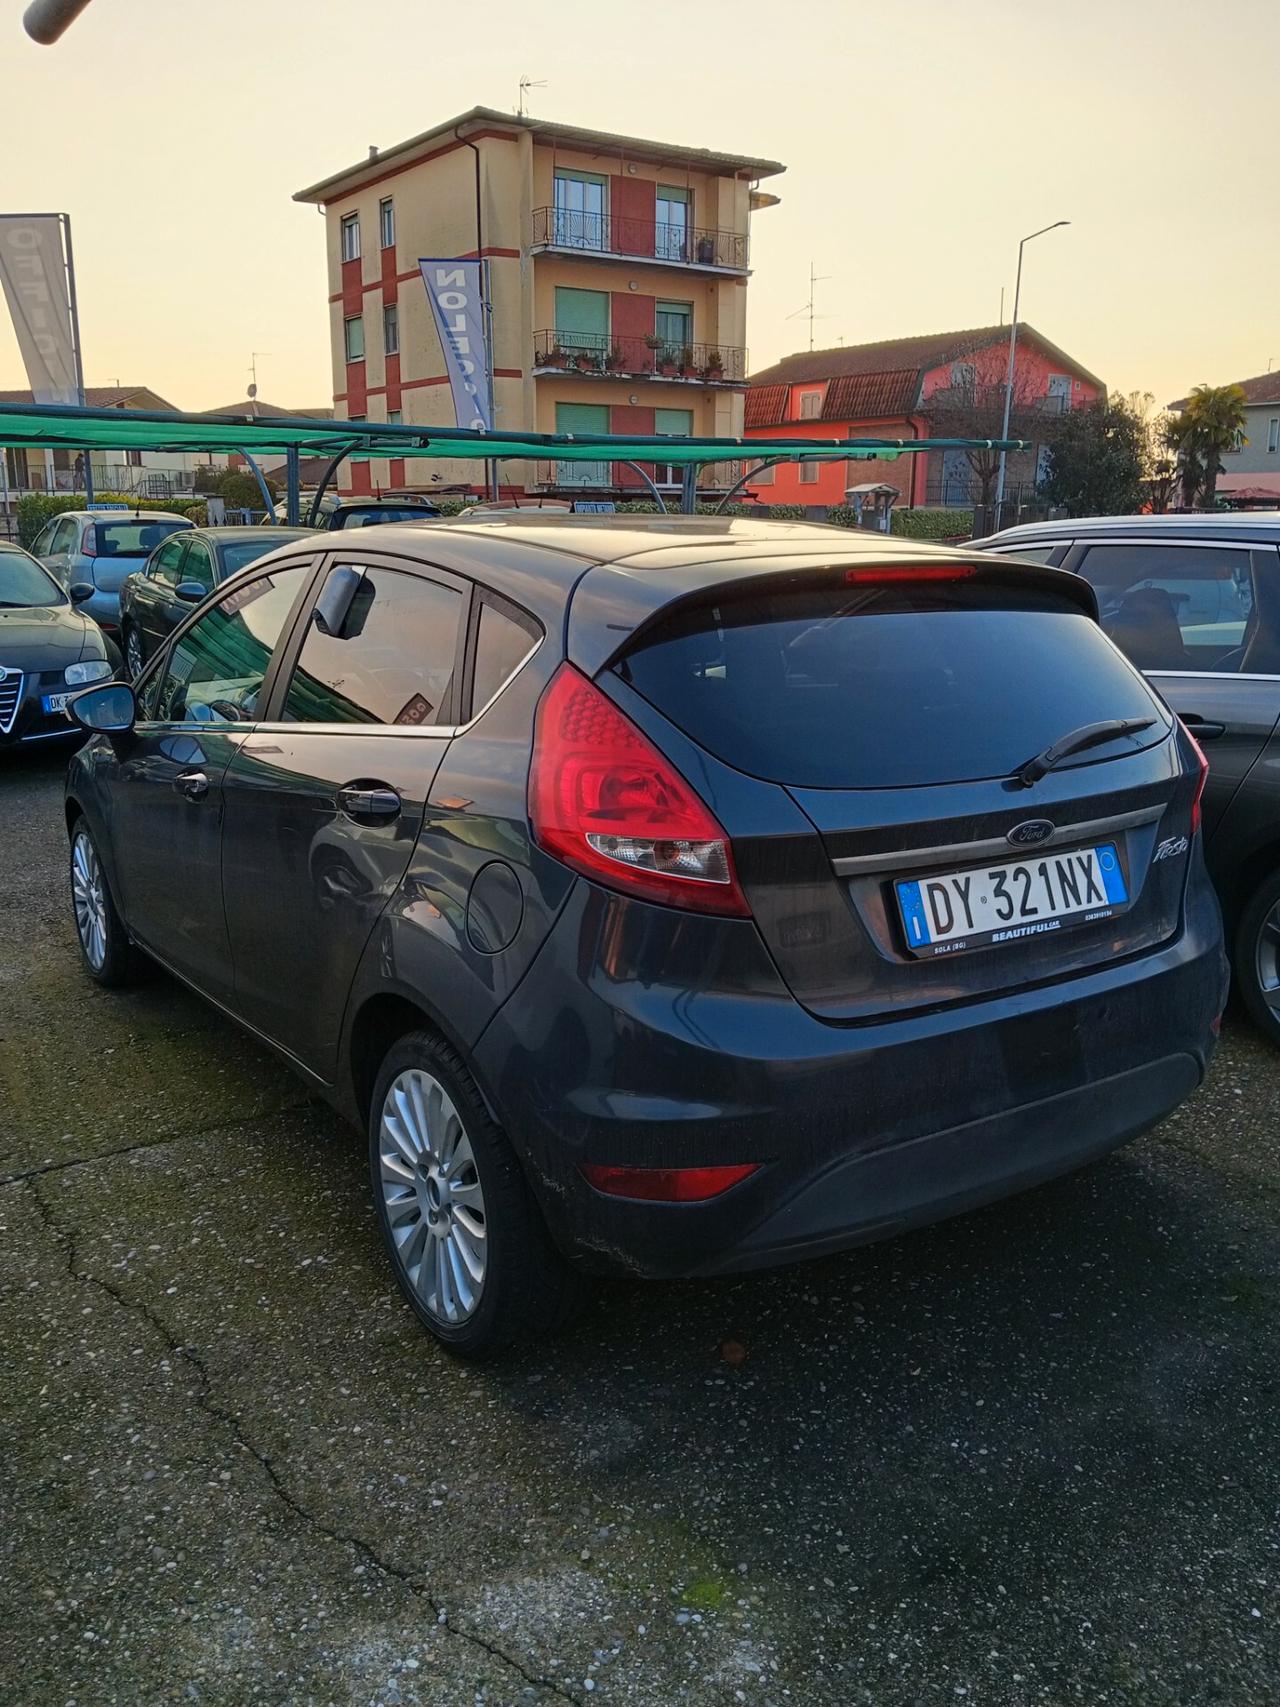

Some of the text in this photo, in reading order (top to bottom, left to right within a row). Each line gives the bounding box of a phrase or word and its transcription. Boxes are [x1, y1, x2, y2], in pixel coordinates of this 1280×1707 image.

[1019, 824, 1046, 841] Ford
[1152, 836, 1189, 863] Fiesta
[926, 876, 974, 935] DY
[988, 853, 1104, 921] 321NX
[992, 925, 1050, 943] BEAUTIFUL
